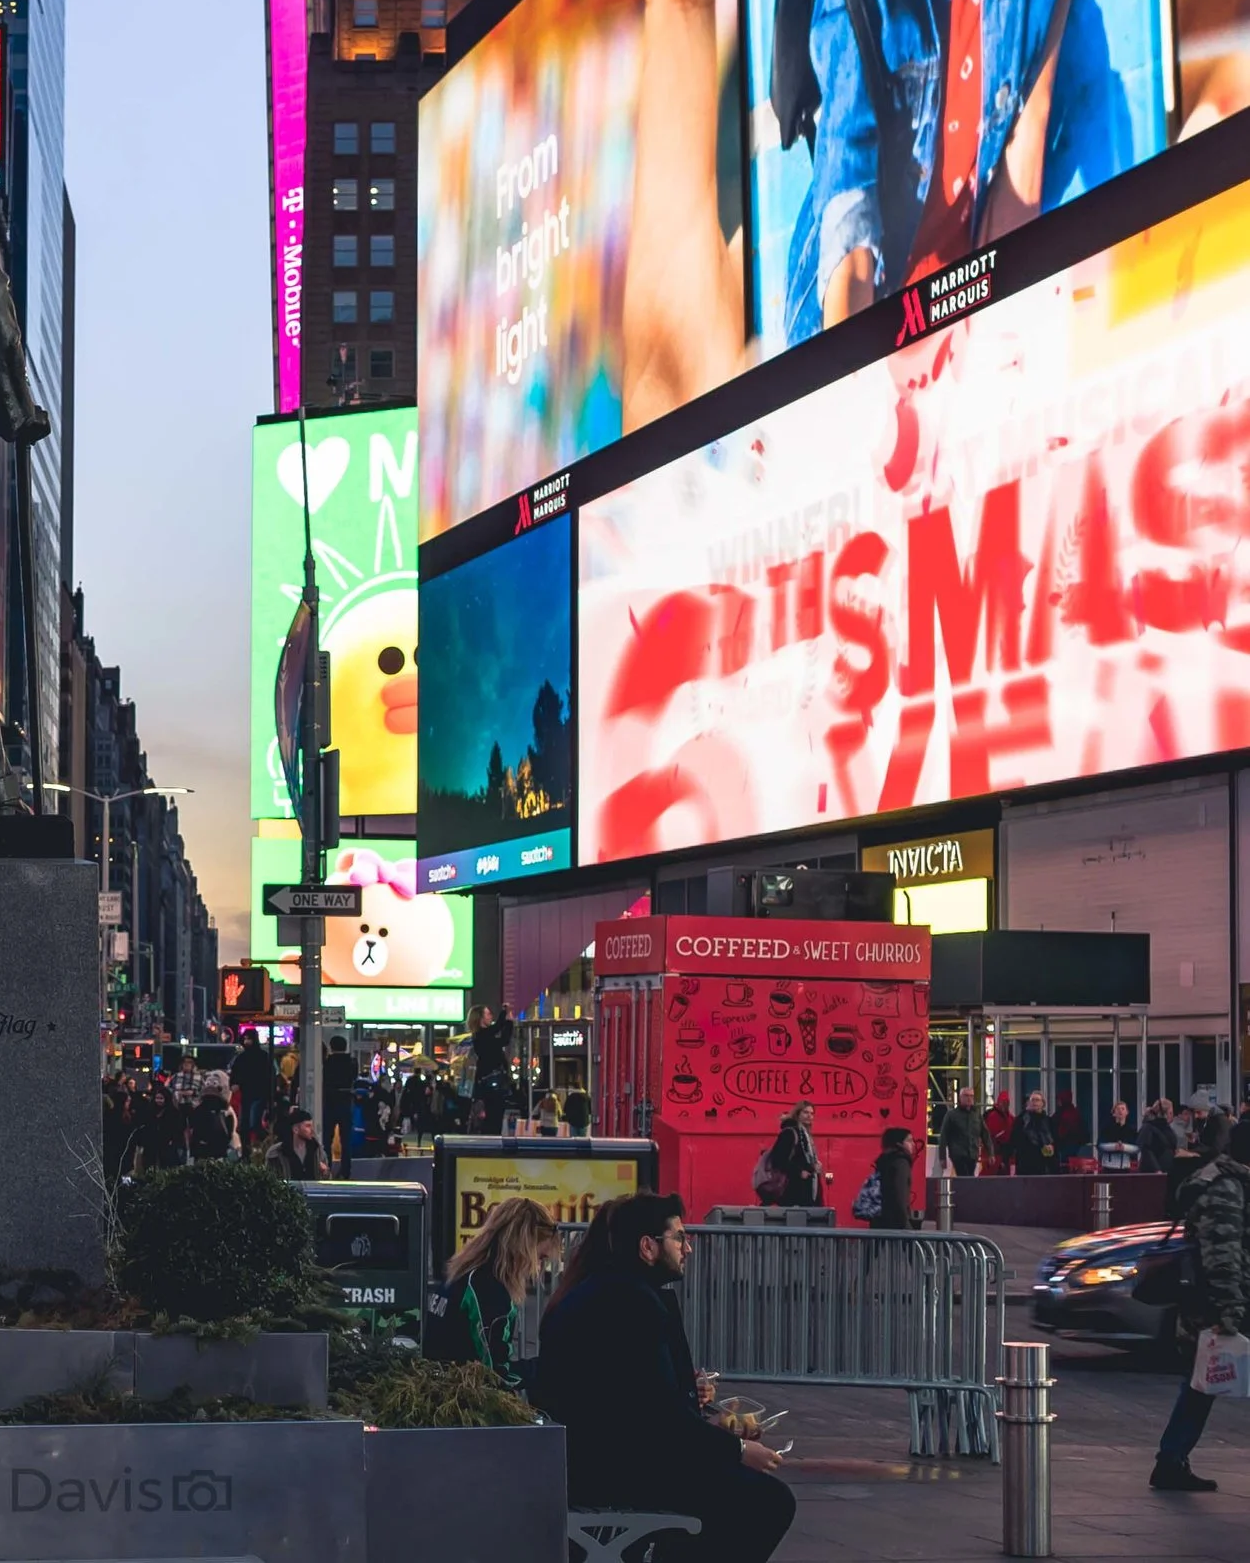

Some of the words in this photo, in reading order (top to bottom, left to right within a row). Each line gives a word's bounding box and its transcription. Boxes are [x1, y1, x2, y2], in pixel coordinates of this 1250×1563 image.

[496, 133, 559, 218] From
[496, 195, 571, 297] bright
[931, 249, 997, 299] MARRIOTT
[931, 279, 989, 322] MARQUIS
[496, 301, 548, 385] light
[533, 473, 571, 502] MARRIOTT
[533, 493, 567, 521] MARQUIS
[887, 840, 964, 879] INVICTA
[293, 893, 321, 907] ONE
[324, 893, 352, 907] WAY
[605, 933, 652, 961] COFFEED
[675, 935, 790, 960] COFFEED
[793, 945, 801, 955] &
[804, 940, 850, 961] SWEET
[856, 942, 921, 964] CHURROS
[711, 1010, 757, 1028] Espresso
[736, 1069, 790, 1095] COFFEE
[800, 1069, 815, 1096] &
[822, 1070, 855, 1096] TEA
[473, 1176, 504, 1184] Brooklyn
[487, 1184, 522, 1192] Broadway
[342, 1287, 396, 1304] TRASH
